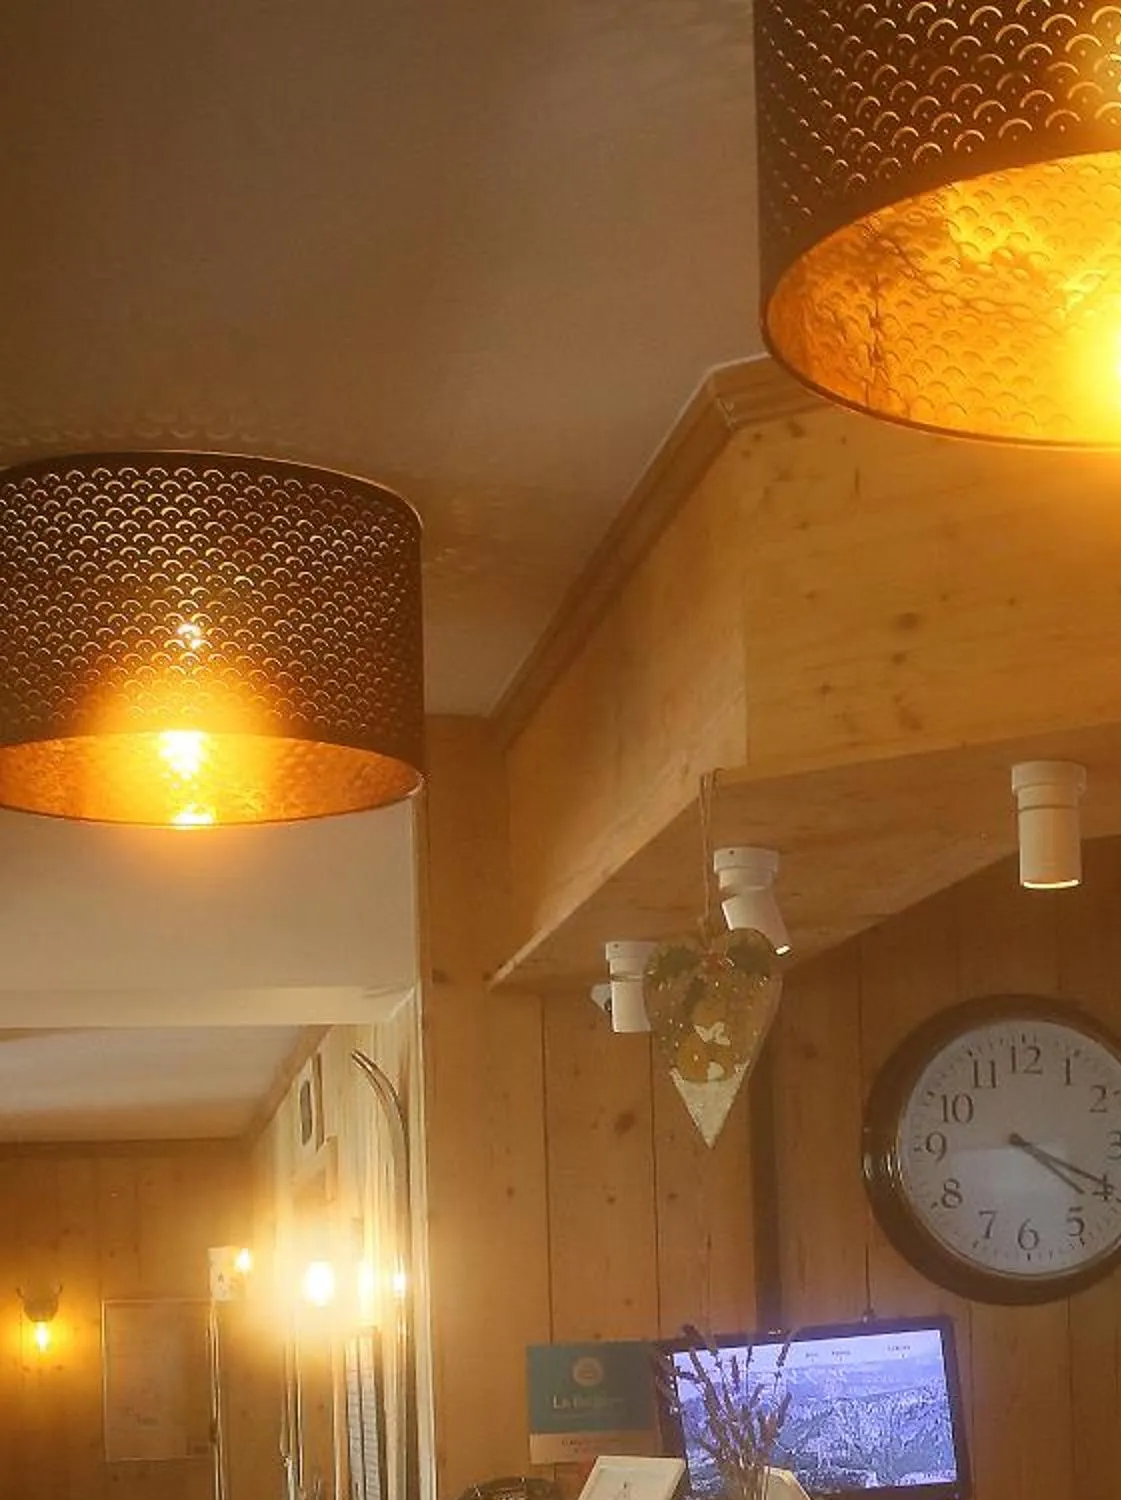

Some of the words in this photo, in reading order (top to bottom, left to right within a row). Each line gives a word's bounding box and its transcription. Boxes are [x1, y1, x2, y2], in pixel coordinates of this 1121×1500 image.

[972, 1058, 998, 1089] 11
[1009, 1045, 1043, 1075] 12
[1063, 1056, 1073, 1086] 1
[941, 1093, 974, 1124] 10
[1090, 1085, 1108, 1114] 2
[926, 1132, 947, 1162] 9
[941, 1179, 963, 1209] 8
[979, 1211, 997, 1240] 7
[1017, 1218, 1040, 1251] 6
[1065, 1207, 1085, 1237] 5
